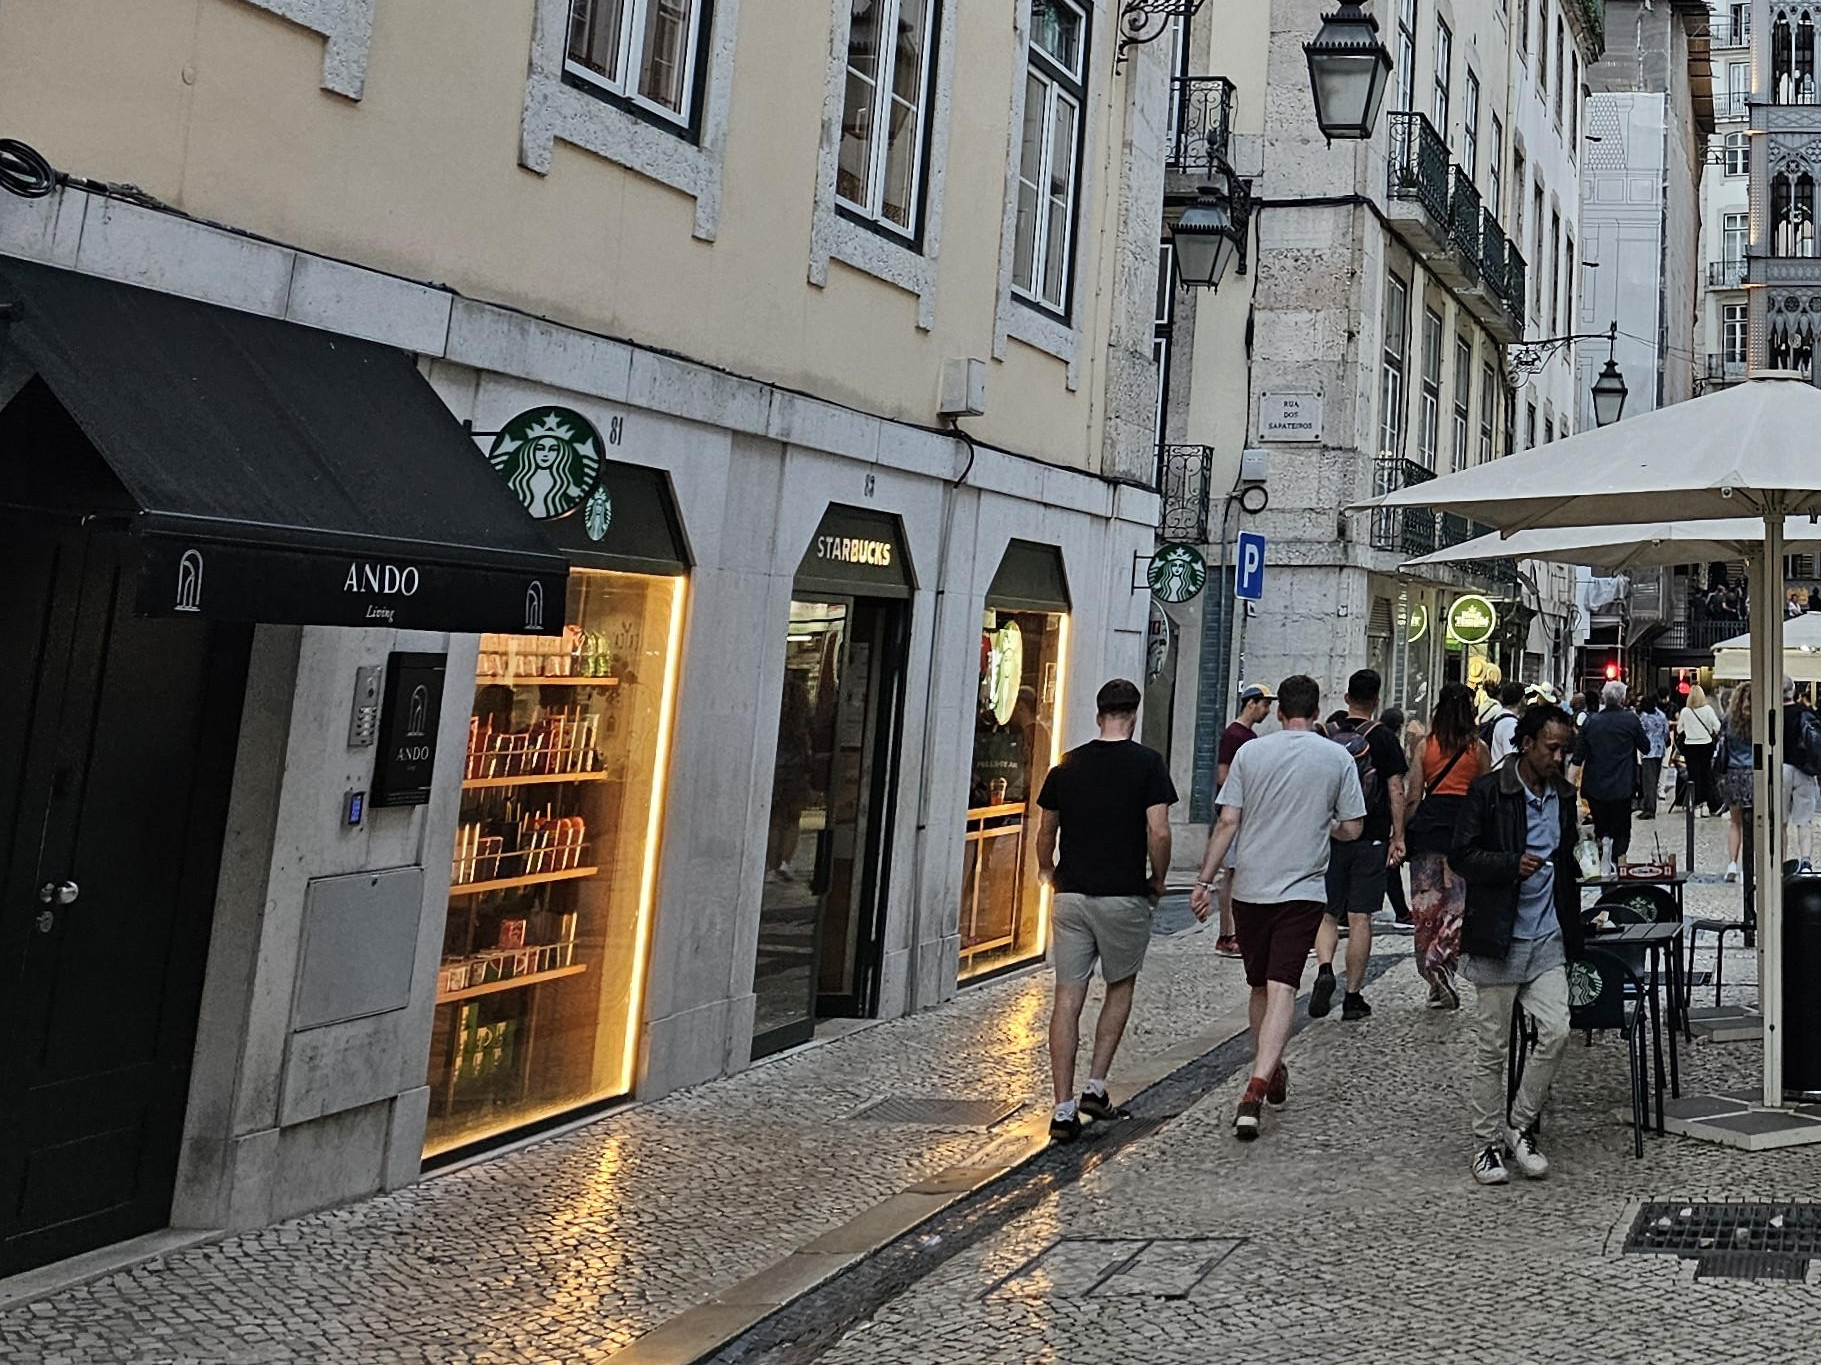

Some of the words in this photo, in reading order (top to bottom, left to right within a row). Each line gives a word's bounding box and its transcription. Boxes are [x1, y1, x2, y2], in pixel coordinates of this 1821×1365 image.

[609, 416, 624, 446] 81
[817, 535, 891, 566] STARBUCKS
[1243, 543, 1259, 588] P
[343, 561, 419, 596] ANDO
[365, 604, 395, 623] Living
[396, 746, 429, 761] ANDO
